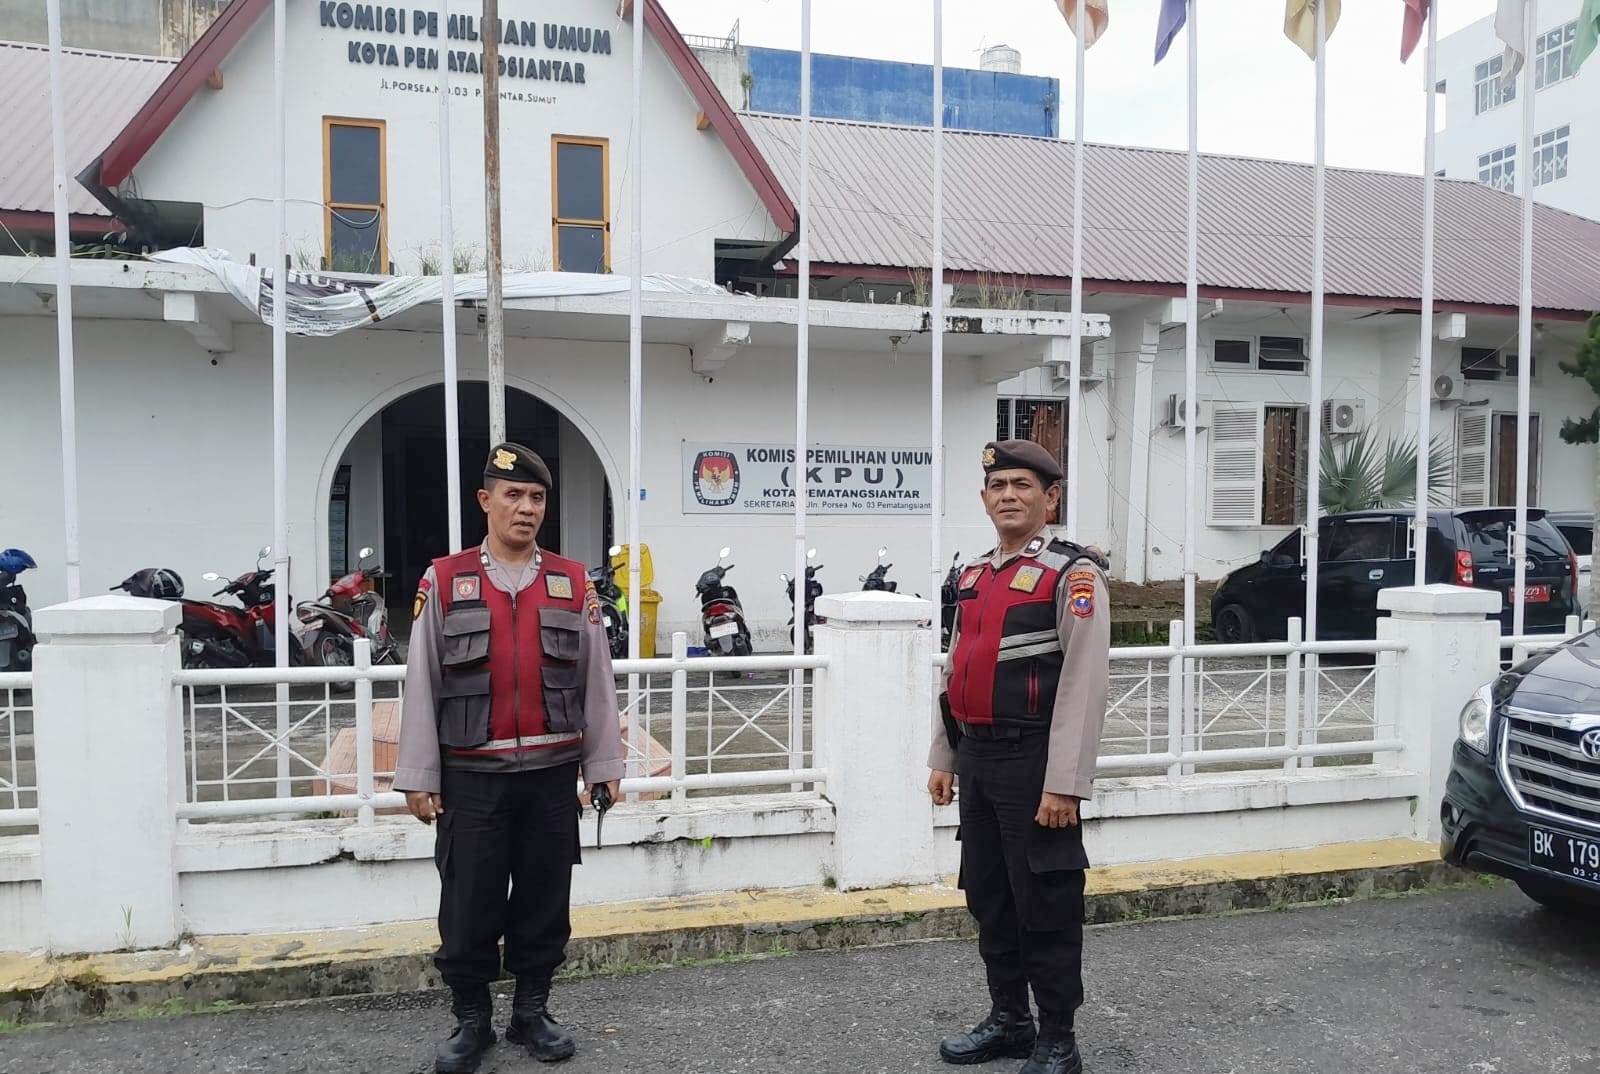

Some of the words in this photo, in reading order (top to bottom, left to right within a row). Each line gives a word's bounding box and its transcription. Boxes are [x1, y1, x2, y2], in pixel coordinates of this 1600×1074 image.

[320, 1, 405, 34] KOMISI
[413, 9, 536, 47] PEMILAN
[543, 23, 611, 55] UMUM
[348, 41, 399, 66] KOTA
[404, 46, 586, 84] PEMATASIANTAR
[746, 449, 796, 463] KOMIS
[806, 449, 886, 464] PEMILIHAN
[743, 500, 796, 508] SEKRETARIA
[866, 501, 875, 509] 03
[877, 501, 933, 511] Pematangsiant
[763, 489, 796, 497] KOTA
[806, 489, 920, 498] EMATANGSIANTAR
[1534, 830, 1554, 857] BK
[1568, 839, 1599, 868] 179
